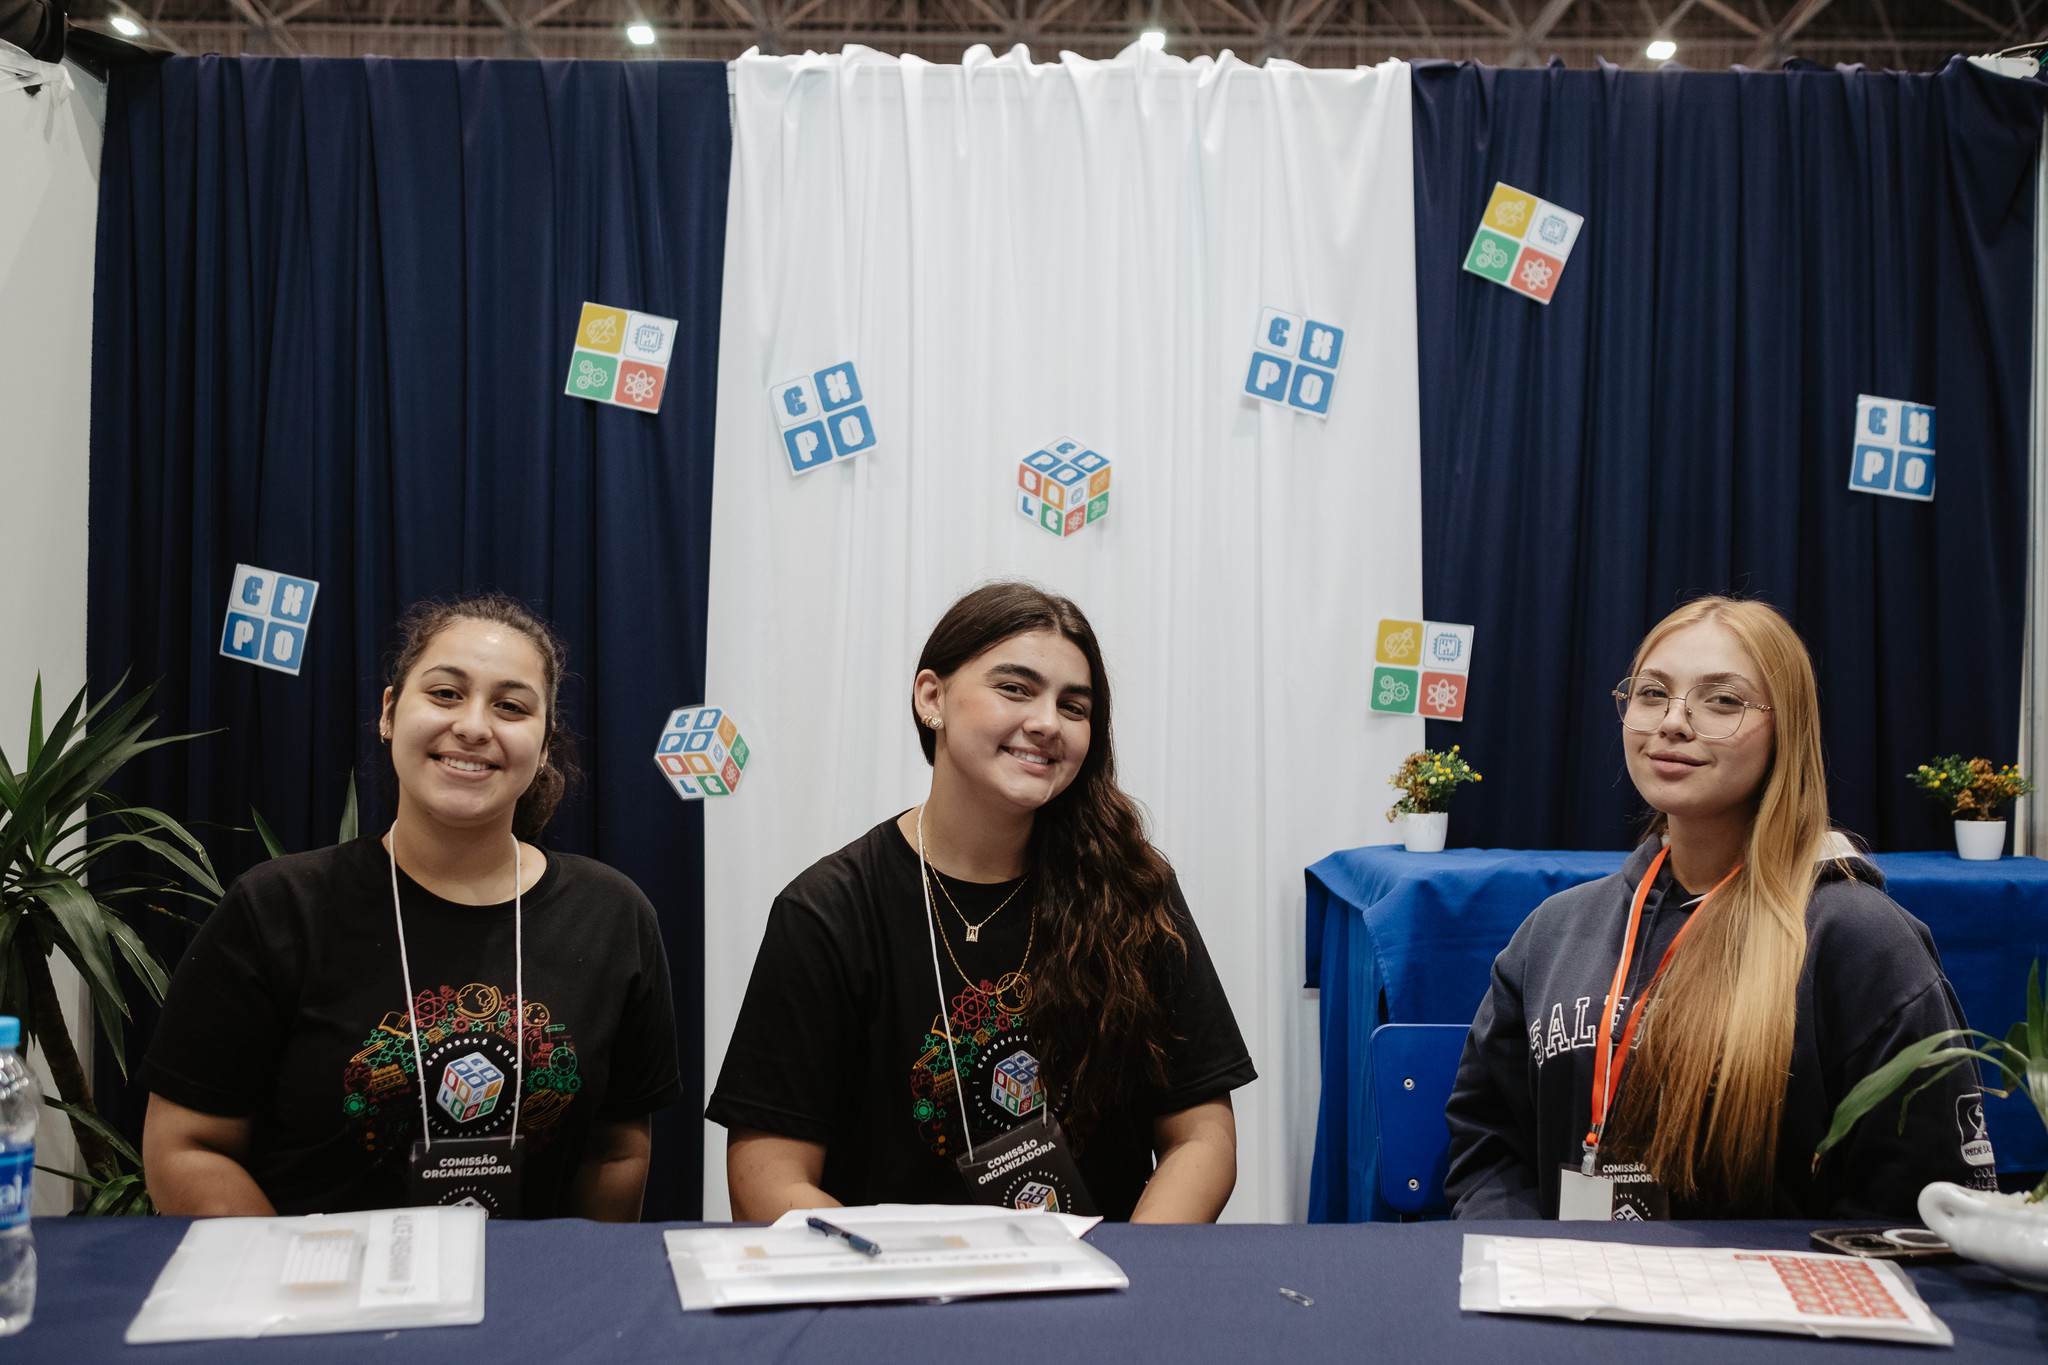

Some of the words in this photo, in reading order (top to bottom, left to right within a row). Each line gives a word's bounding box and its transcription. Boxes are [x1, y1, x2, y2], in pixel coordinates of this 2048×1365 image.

[1530, 995, 1664, 1068] SAL
[439, 1154, 498, 1168] COMISSÃO
[978, 1141, 1056, 1185] ORGANIZADORA
[987, 1139, 1038, 1169] COMISSÃO
[422, 1164, 512, 1179] ORGANIZADORA
[1602, 1161, 1647, 1173] COMISSÃO
